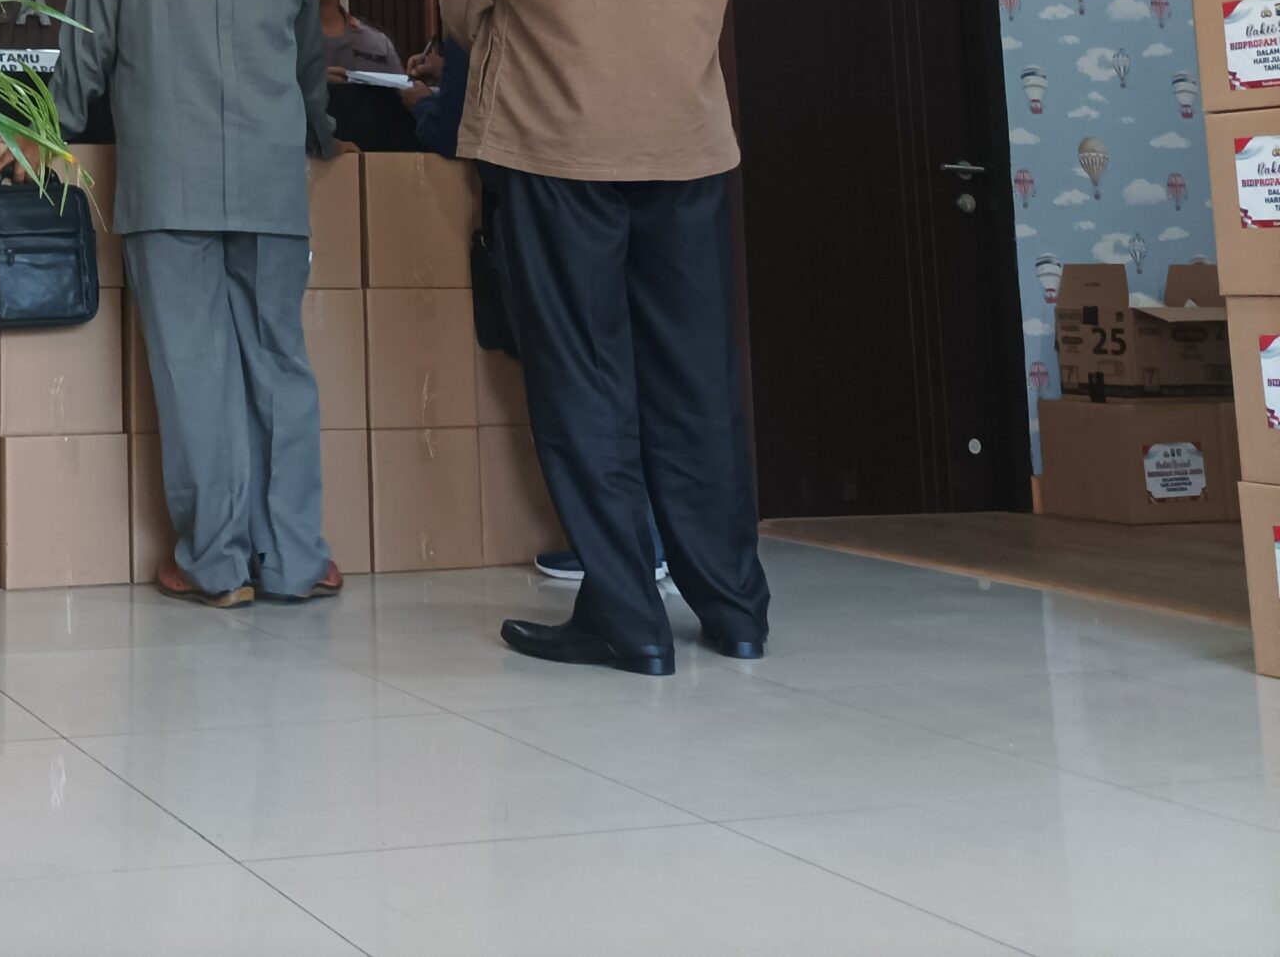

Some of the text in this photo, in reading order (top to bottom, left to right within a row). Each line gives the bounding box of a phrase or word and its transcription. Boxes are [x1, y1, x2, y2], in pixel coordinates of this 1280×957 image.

[1229, 38, 1277, 51] BIDPROPAM
[1256, 48, 1280, 57] DALAM
[1253, 57, 1269, 65] HARI
[1241, 178, 1280, 187] BIDPROPA
[1091, 327, 1127, 355] 25
